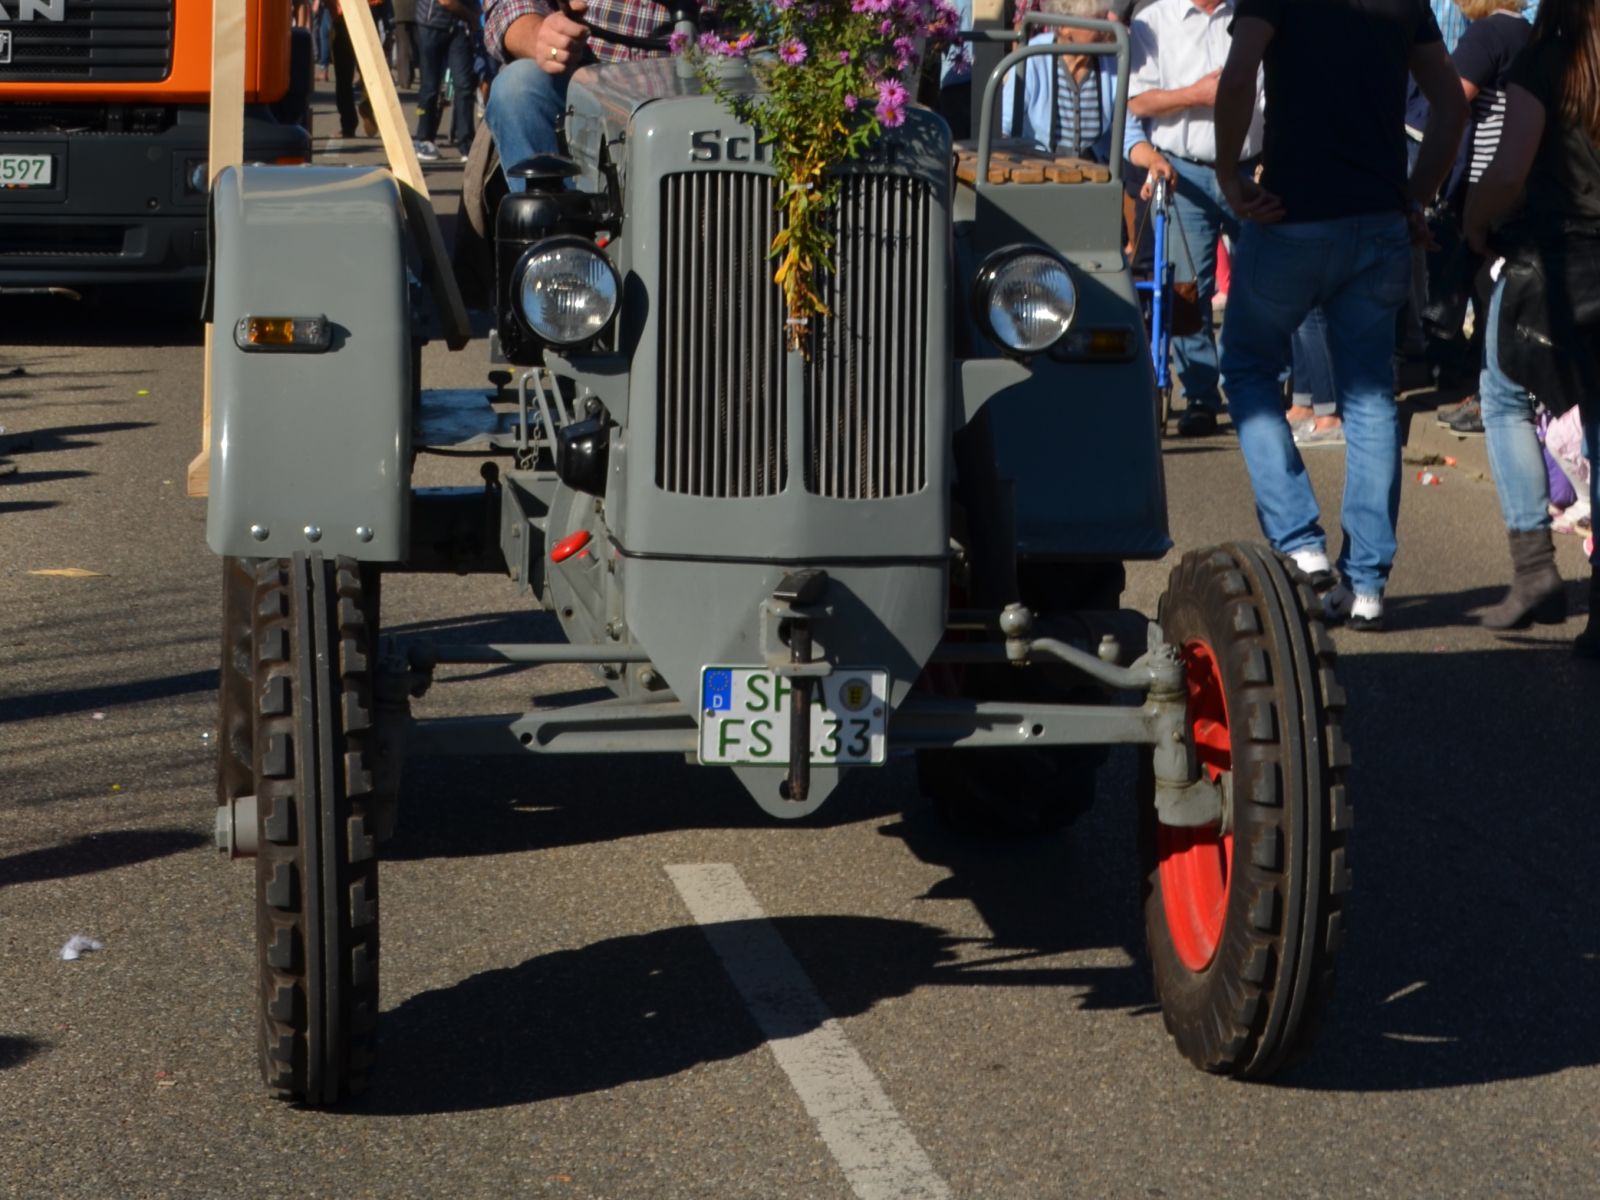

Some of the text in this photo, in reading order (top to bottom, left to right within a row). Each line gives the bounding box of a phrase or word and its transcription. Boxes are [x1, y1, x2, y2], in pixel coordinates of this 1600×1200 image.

[0, 158, 46, 180] 597
[712, 695, 724, 709] D
[718, 718, 773, 758] FS
